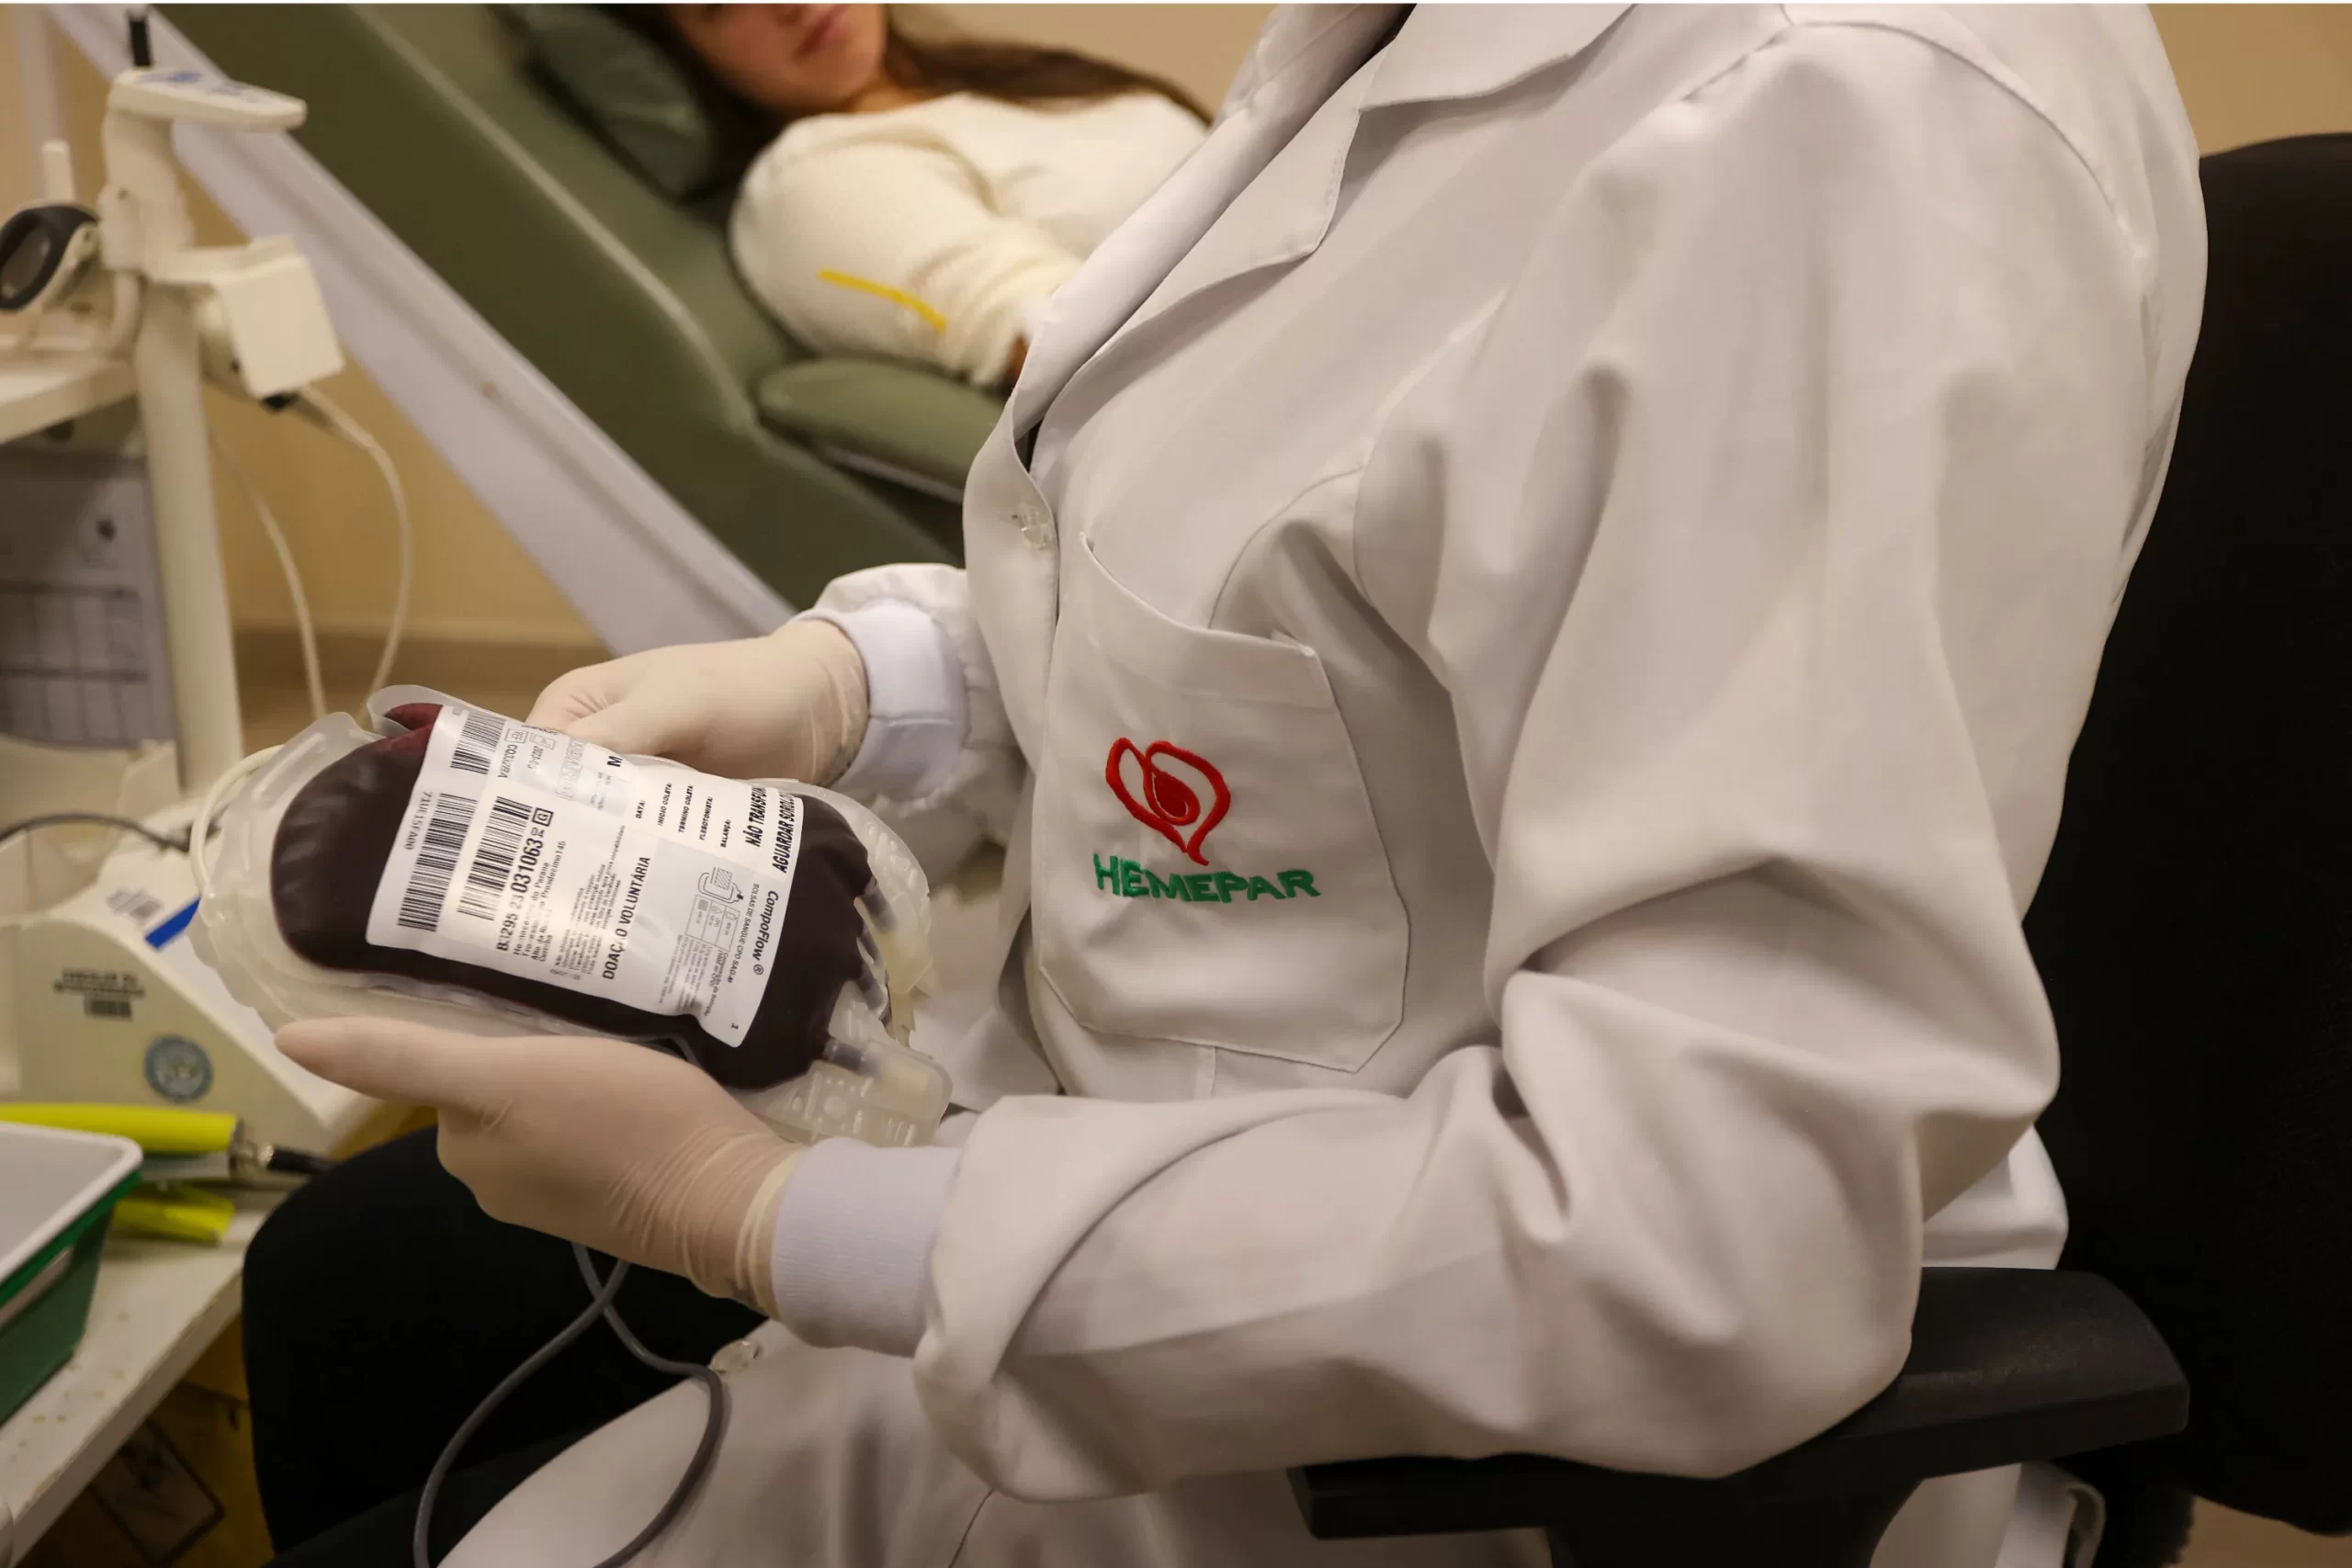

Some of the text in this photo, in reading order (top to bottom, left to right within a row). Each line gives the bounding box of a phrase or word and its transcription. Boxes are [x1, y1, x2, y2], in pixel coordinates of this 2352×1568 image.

[742, 825, 763, 848] NÃO
[772, 819, 795, 874] AGUARDAR
[511, 838, 544, 894] 031063
[1093, 852, 1321, 903] HEMEPAR
[745, 908, 754, 918] DE
[748, 883, 760, 908] BOLSAS
[601, 928, 628, 981] DOAÇO
[618, 857, 651, 924] VOLUNTÁRIA
[738, 917, 752, 945] SANGUE
[752, 890, 779, 962] CompoFlow
[734, 944, 744, 960] CPD
